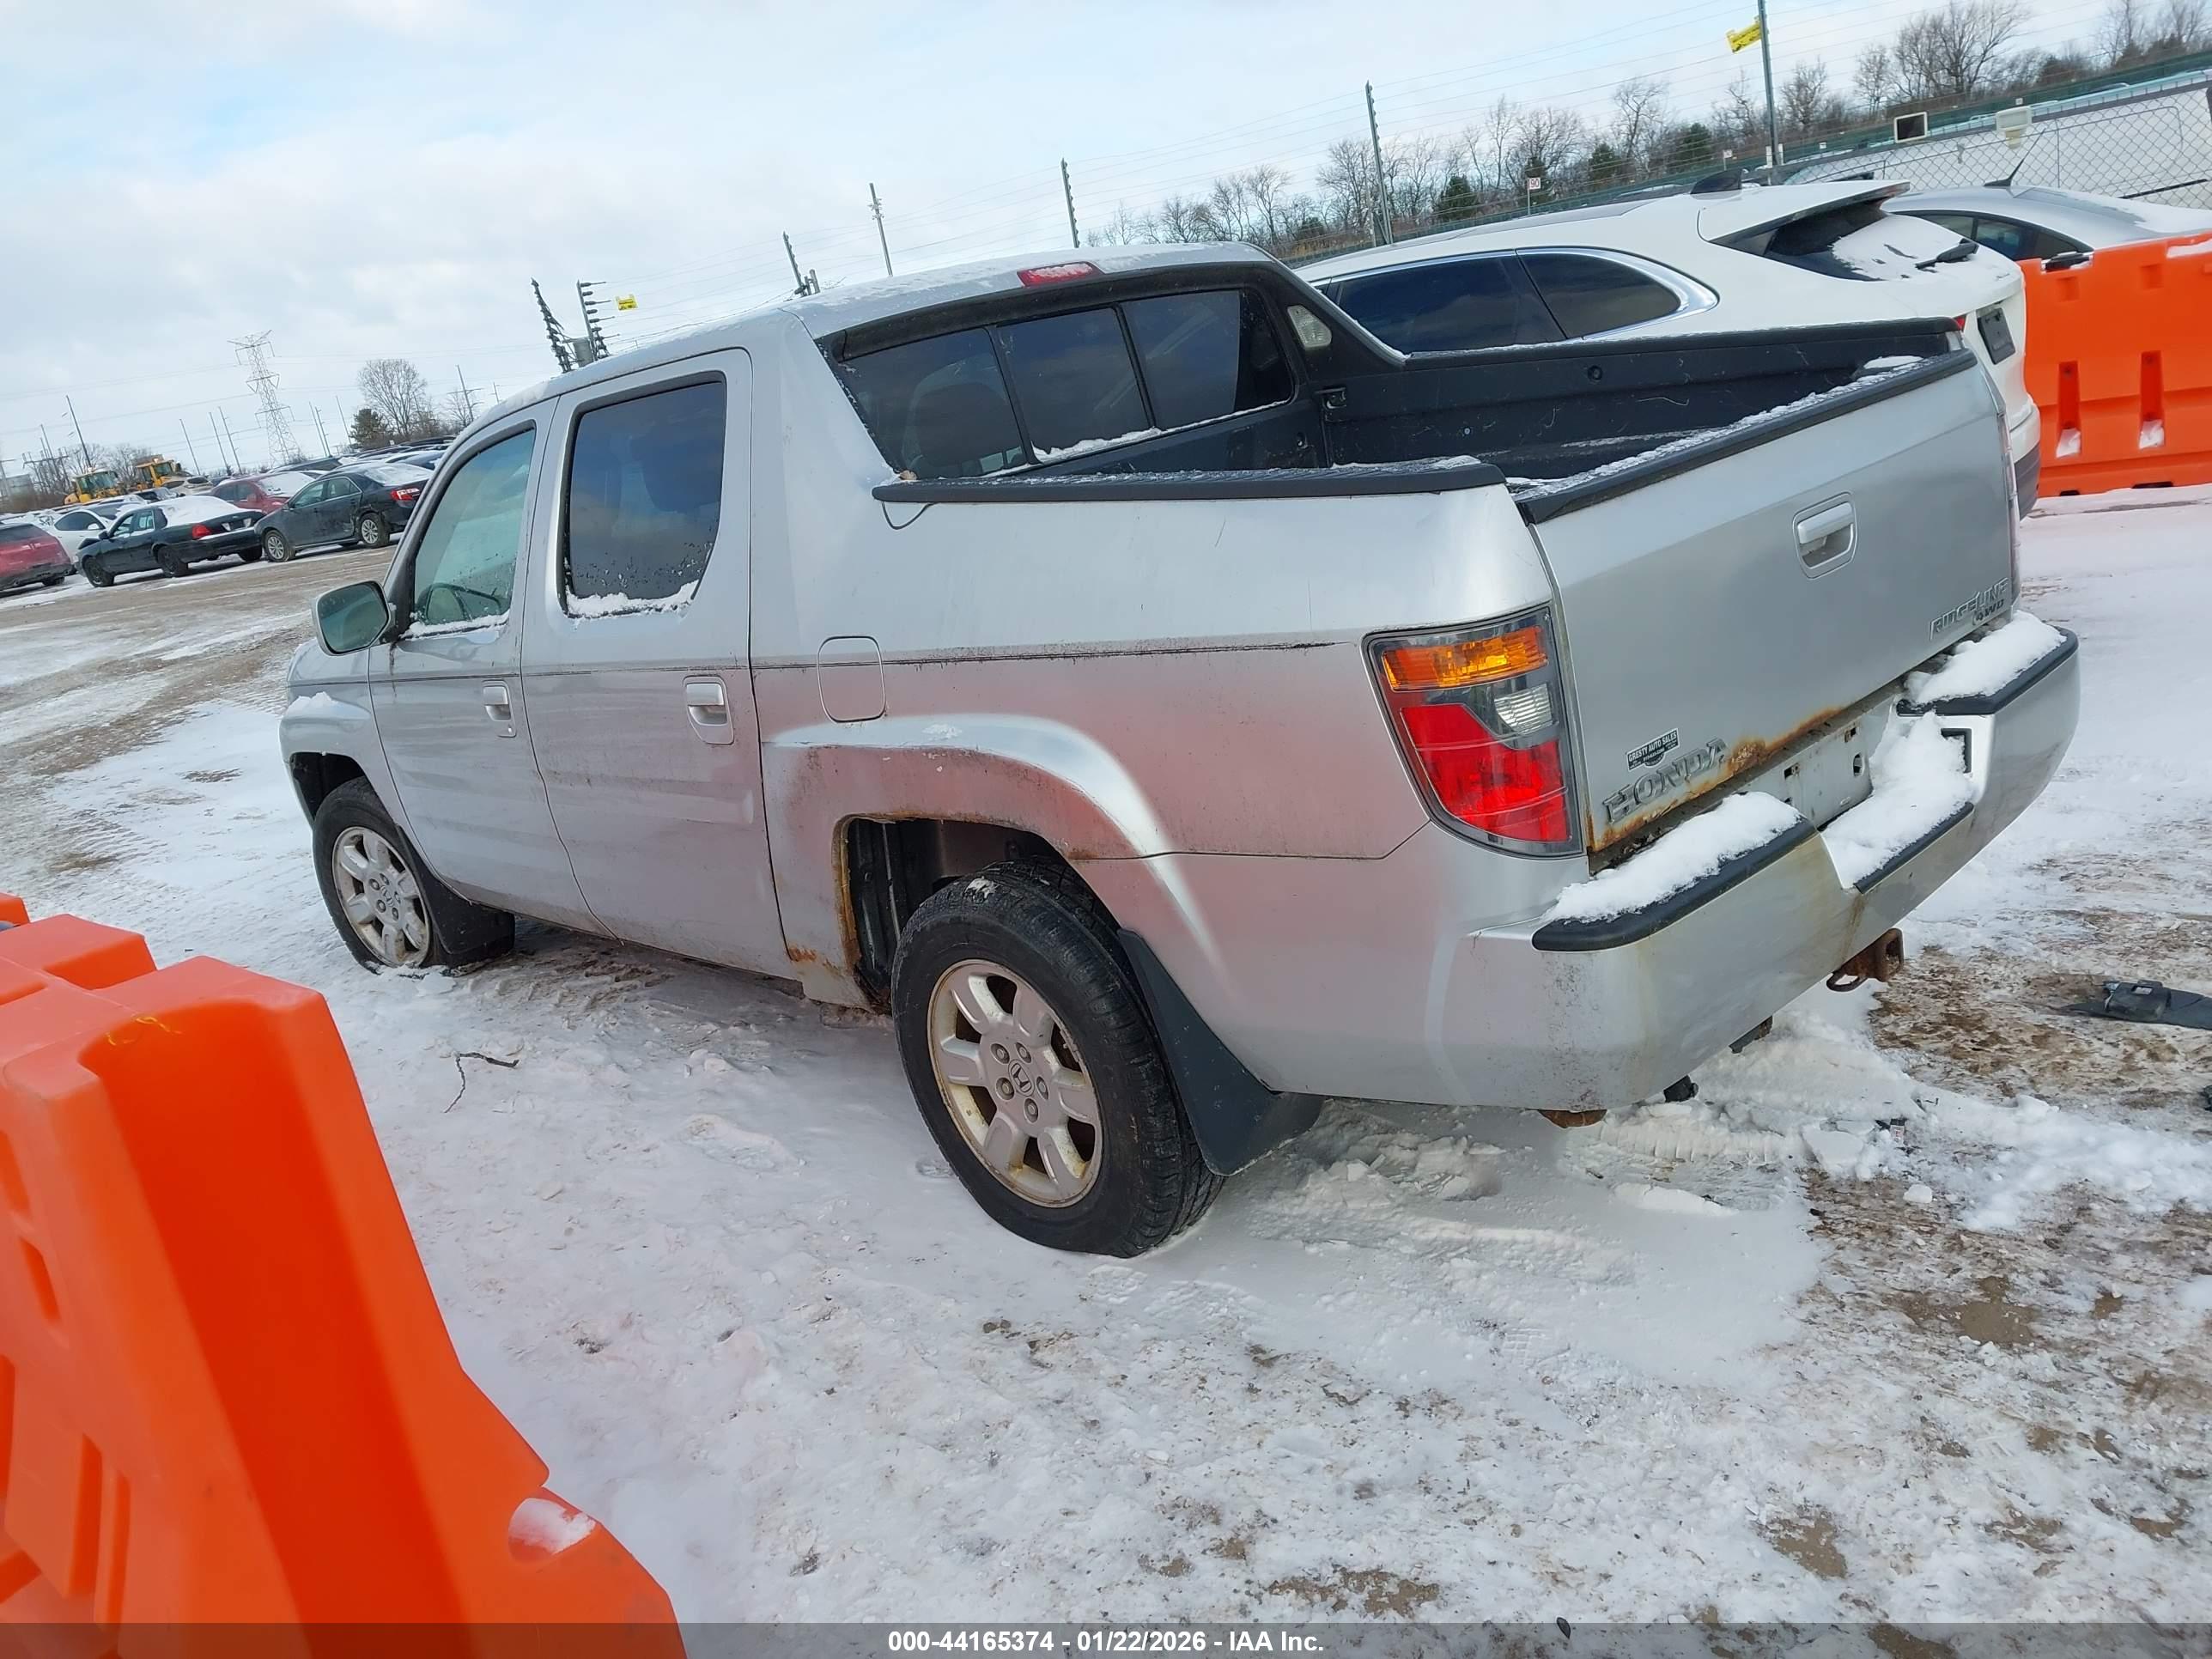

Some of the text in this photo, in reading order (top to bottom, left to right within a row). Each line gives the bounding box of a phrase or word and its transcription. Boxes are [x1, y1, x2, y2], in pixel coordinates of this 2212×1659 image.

[1929, 576, 2008, 641] RIDGELINE
[1628, 746, 1648, 763] GRESTY
[1649, 739, 1662, 752] AUTO
[1662, 731, 1677, 745] SALES
[1601, 737, 1729, 825] HONDA
